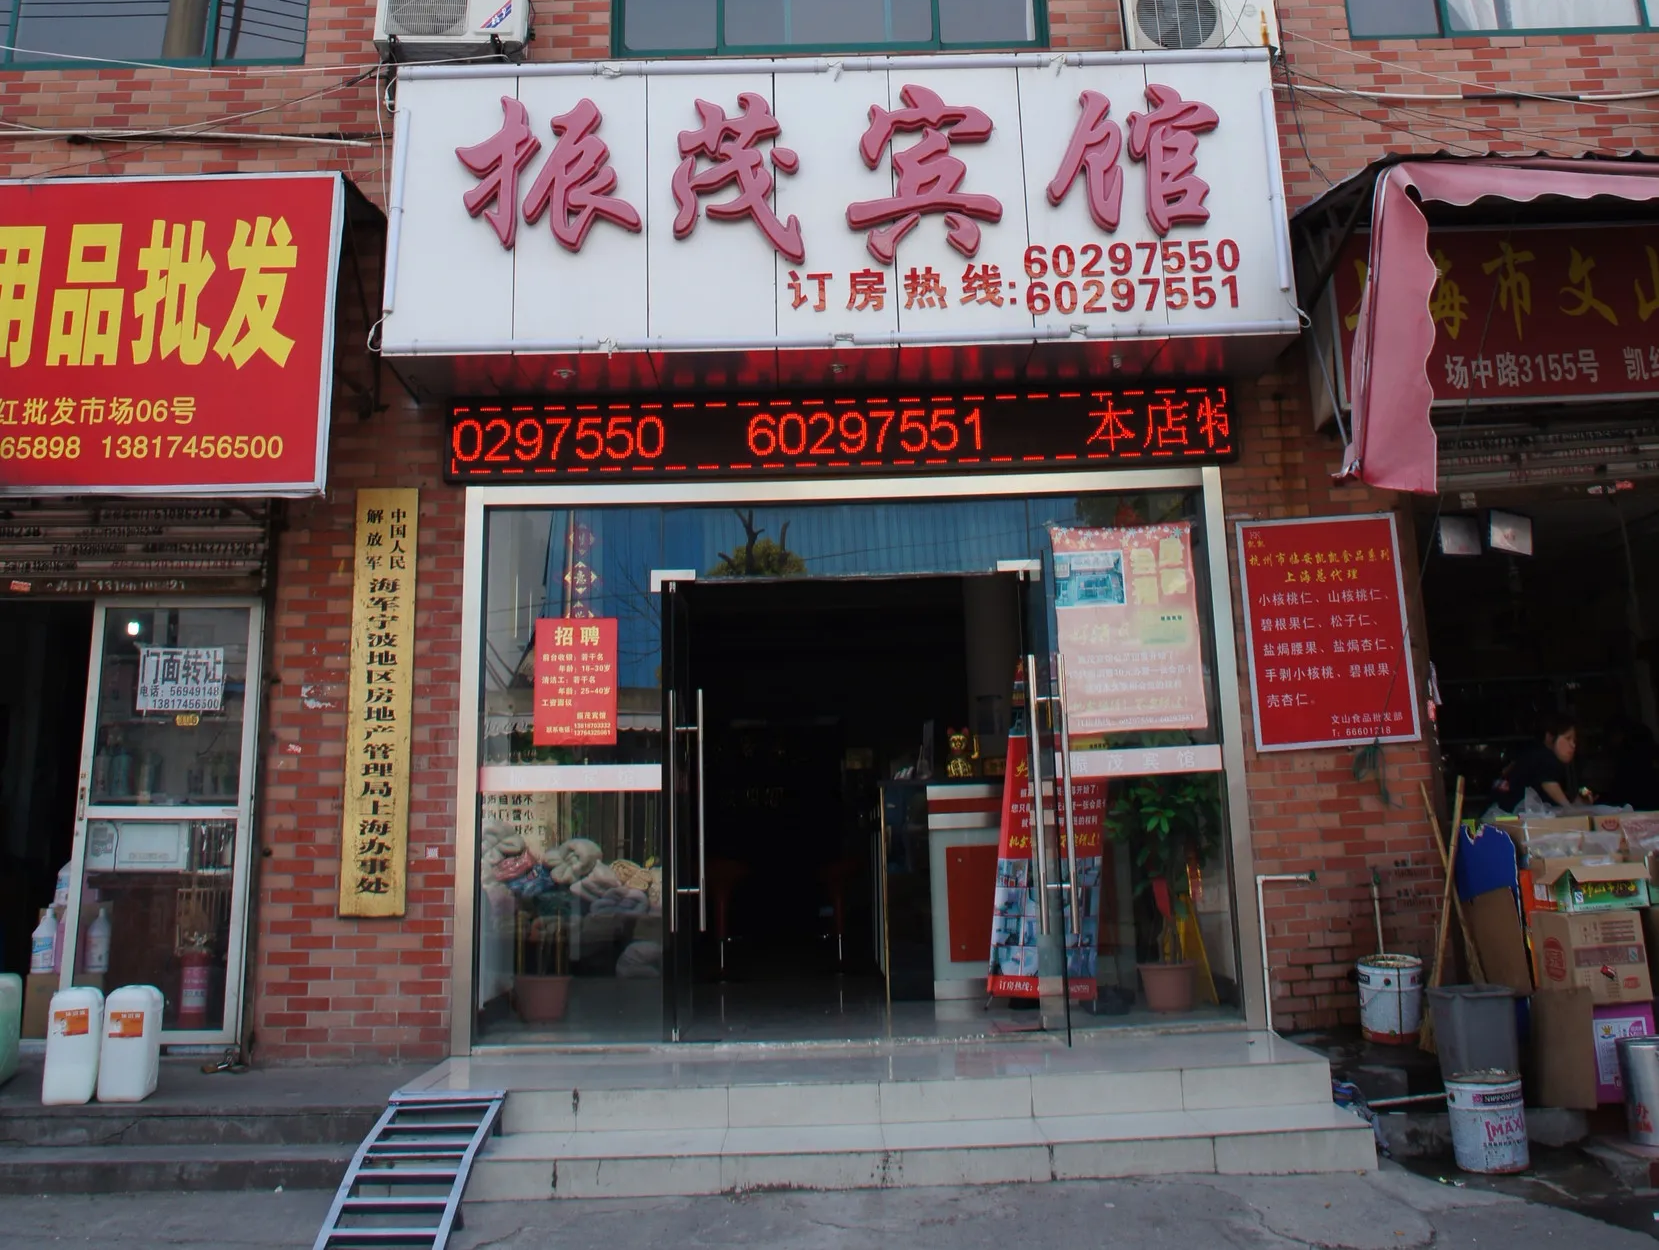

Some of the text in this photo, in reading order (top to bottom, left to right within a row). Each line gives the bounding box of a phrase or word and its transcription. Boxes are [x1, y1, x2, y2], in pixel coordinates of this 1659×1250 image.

[455, 83, 1220, 266] 振茂宾馆
[1024, 239, 1241, 280] 60297550
[1026, 275, 1241, 314] 60297551
[1446, 348, 1600, 391] 场中路3155号
[0, 435, 284, 459] 65898 13817456500
[453, 416, 664, 461] 0297550
[748, 408, 984, 458] 60297551
[365, 508, 384, 571] 解放军
[390, 507, 407, 570] 中国人民
[1285, 568, 1359, 583] 上海总代理
[555, 626, 600, 646] 招聘
[141, 649, 222, 685] 门面转让
[153, 699, 219, 710] 13817456500
